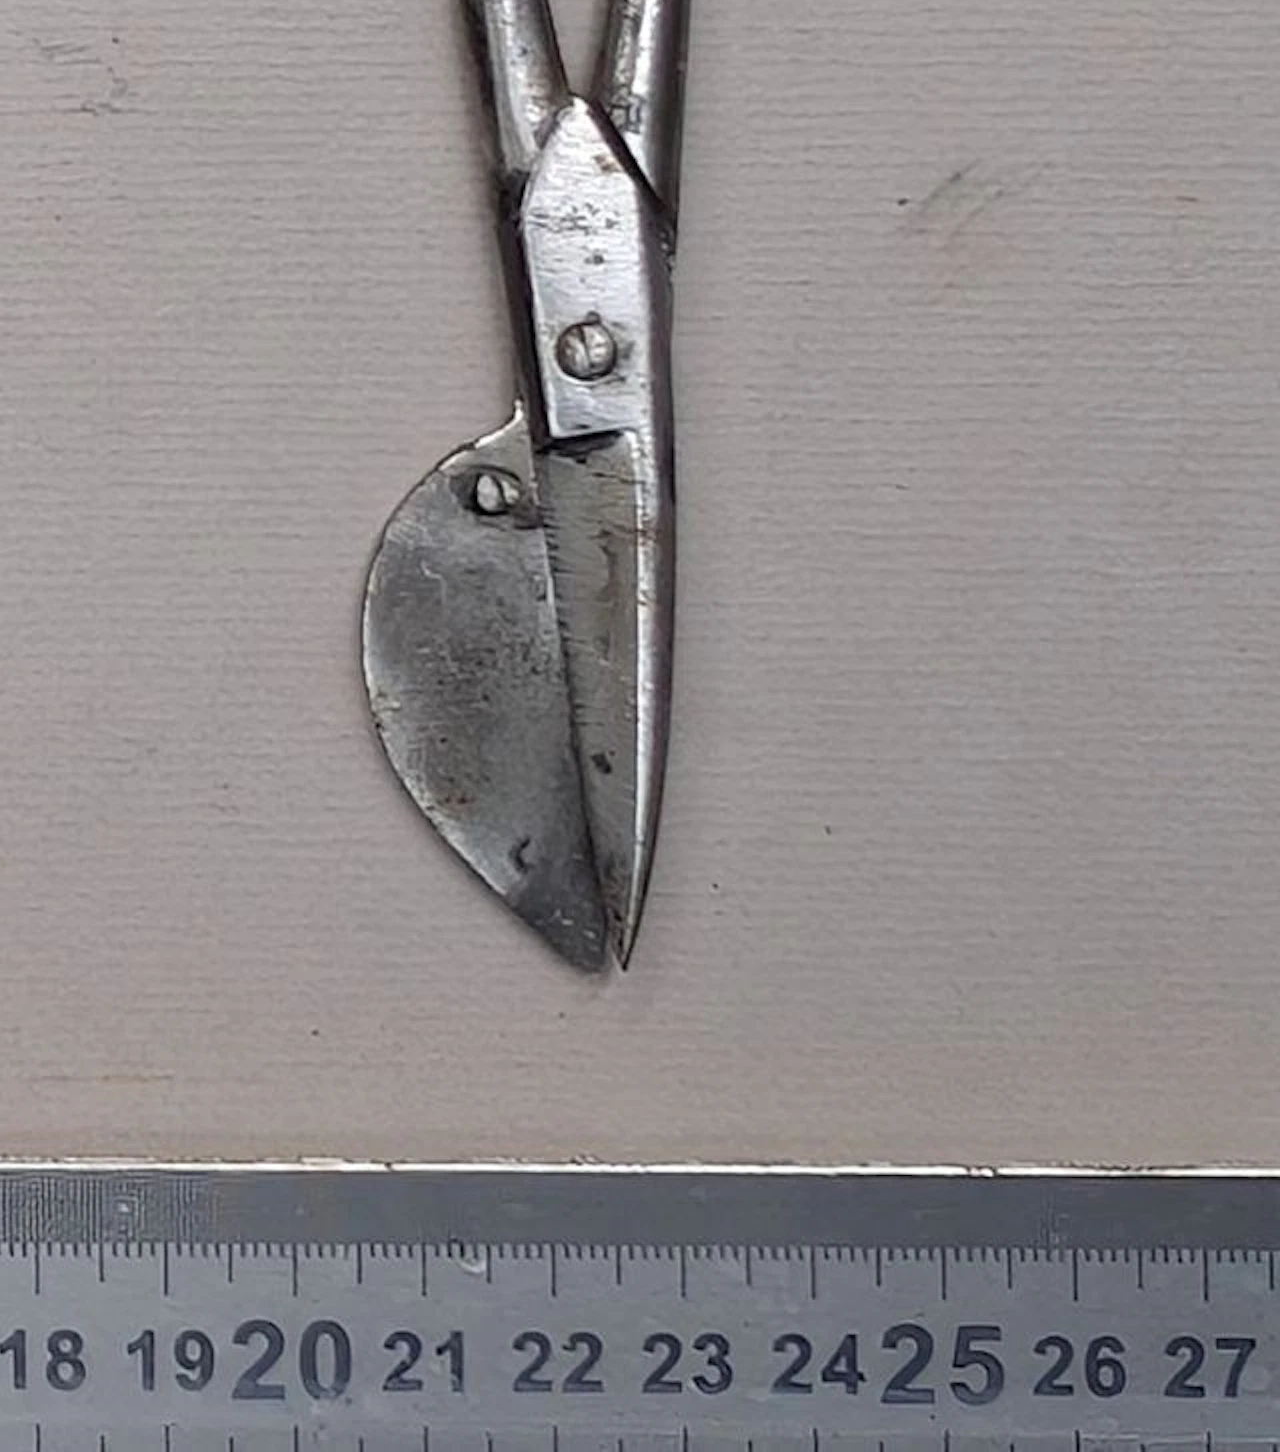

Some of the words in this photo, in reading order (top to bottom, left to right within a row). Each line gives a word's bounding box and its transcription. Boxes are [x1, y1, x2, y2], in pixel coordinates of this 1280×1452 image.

[126, 1329, 215, 1391] 19
[231, 1318, 353, 1401] 20
[382, 1330, 466, 1393] 21
[512, 1331, 604, 1394] 22
[642, 1331, 734, 1395] 23
[772, 1333, 867, 1396] 24
[880, 1323, 1006, 1406] 25
[1033, 1334, 1128, 1398] 26
[1163, 1335, 1258, 1399] 27
